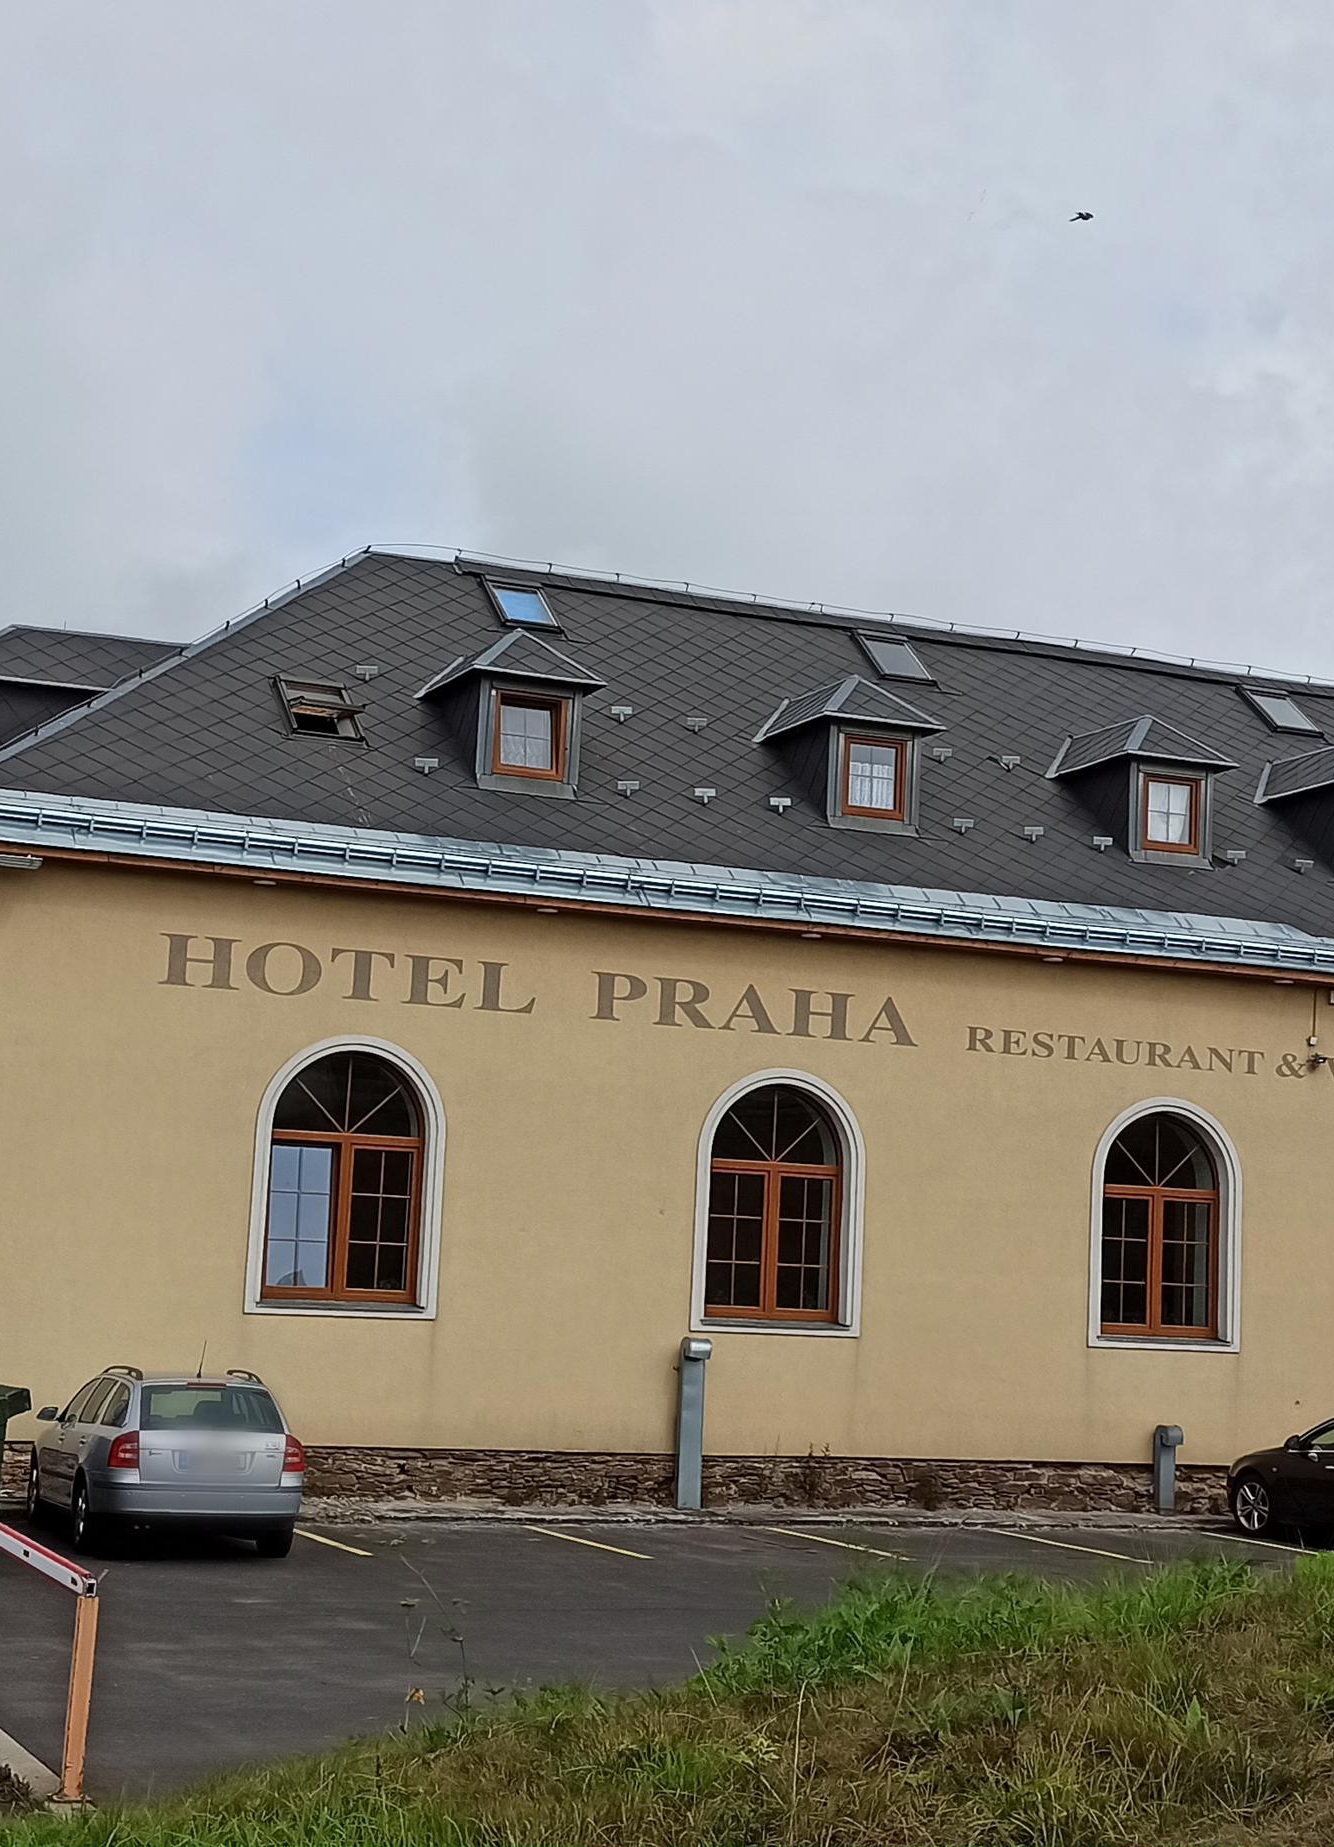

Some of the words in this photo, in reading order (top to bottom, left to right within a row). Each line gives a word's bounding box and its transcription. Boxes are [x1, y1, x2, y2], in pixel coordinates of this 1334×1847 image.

[158, 931, 538, 1015] HOTEL
[589, 970, 919, 1047] PRAHA
[966, 1025, 1265, 1076] RESTAURANT
[1275, 1052, 1307, 1079] &
